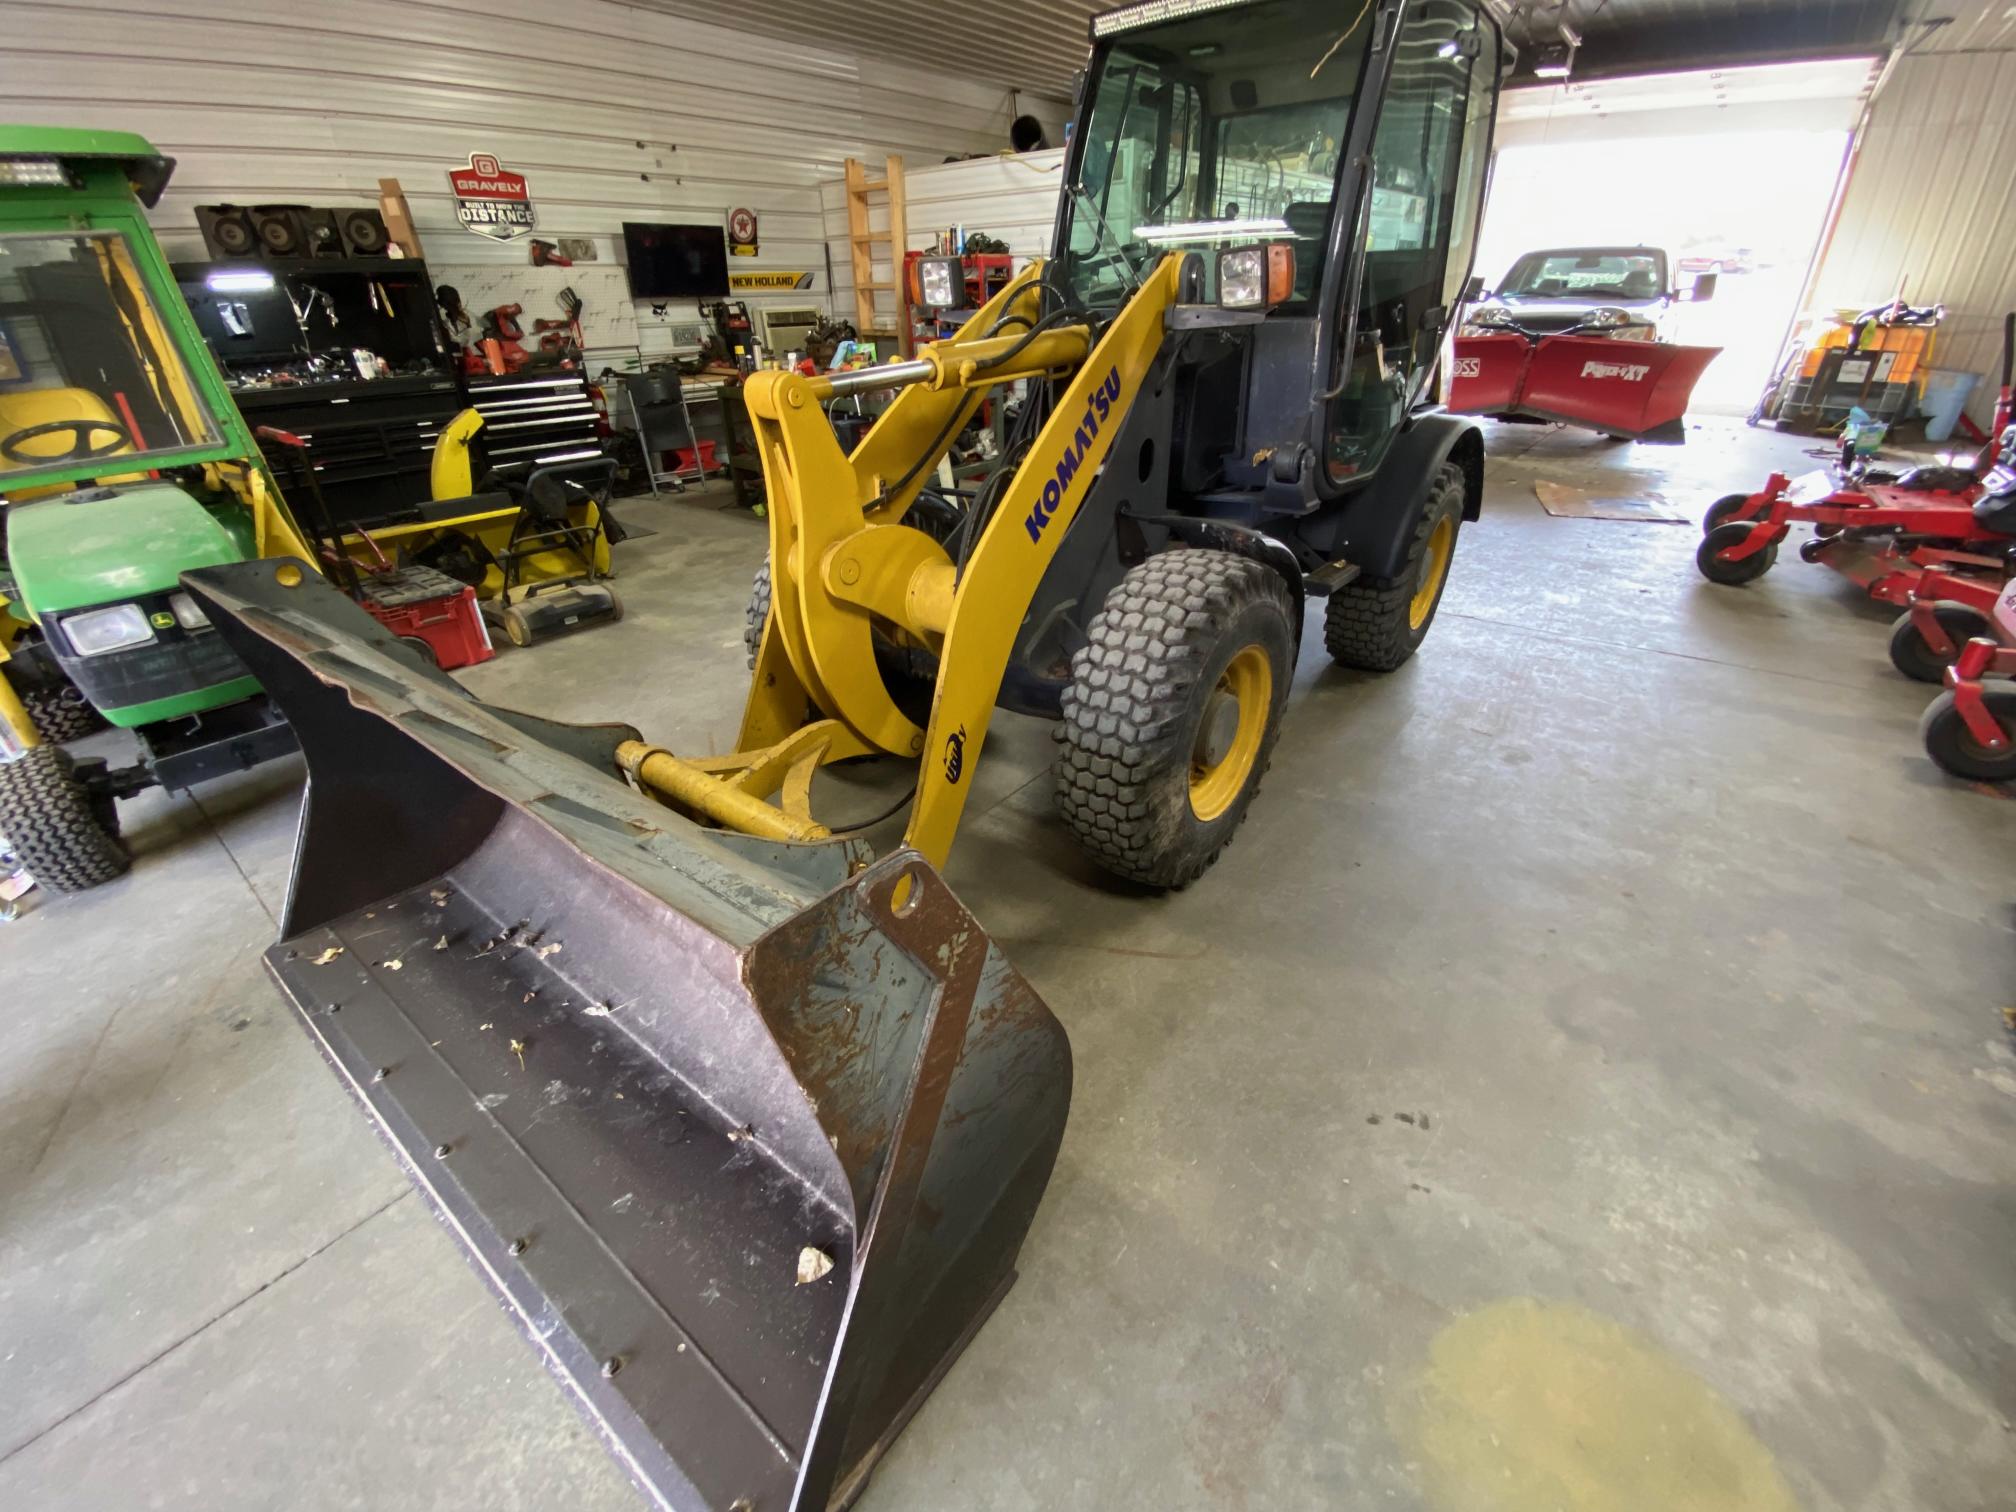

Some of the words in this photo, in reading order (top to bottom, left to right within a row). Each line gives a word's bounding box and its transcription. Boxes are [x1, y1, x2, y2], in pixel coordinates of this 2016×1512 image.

[456, 179, 522, 193] GRAVELY
[460, 208, 535, 223] DISTANCE
[732, 276, 753, 287] NEW
[755, 276, 794, 287] HOLLAND
[1453, 360, 1478, 375] OSS
[1024, 365, 1121, 545] KOMATSU
